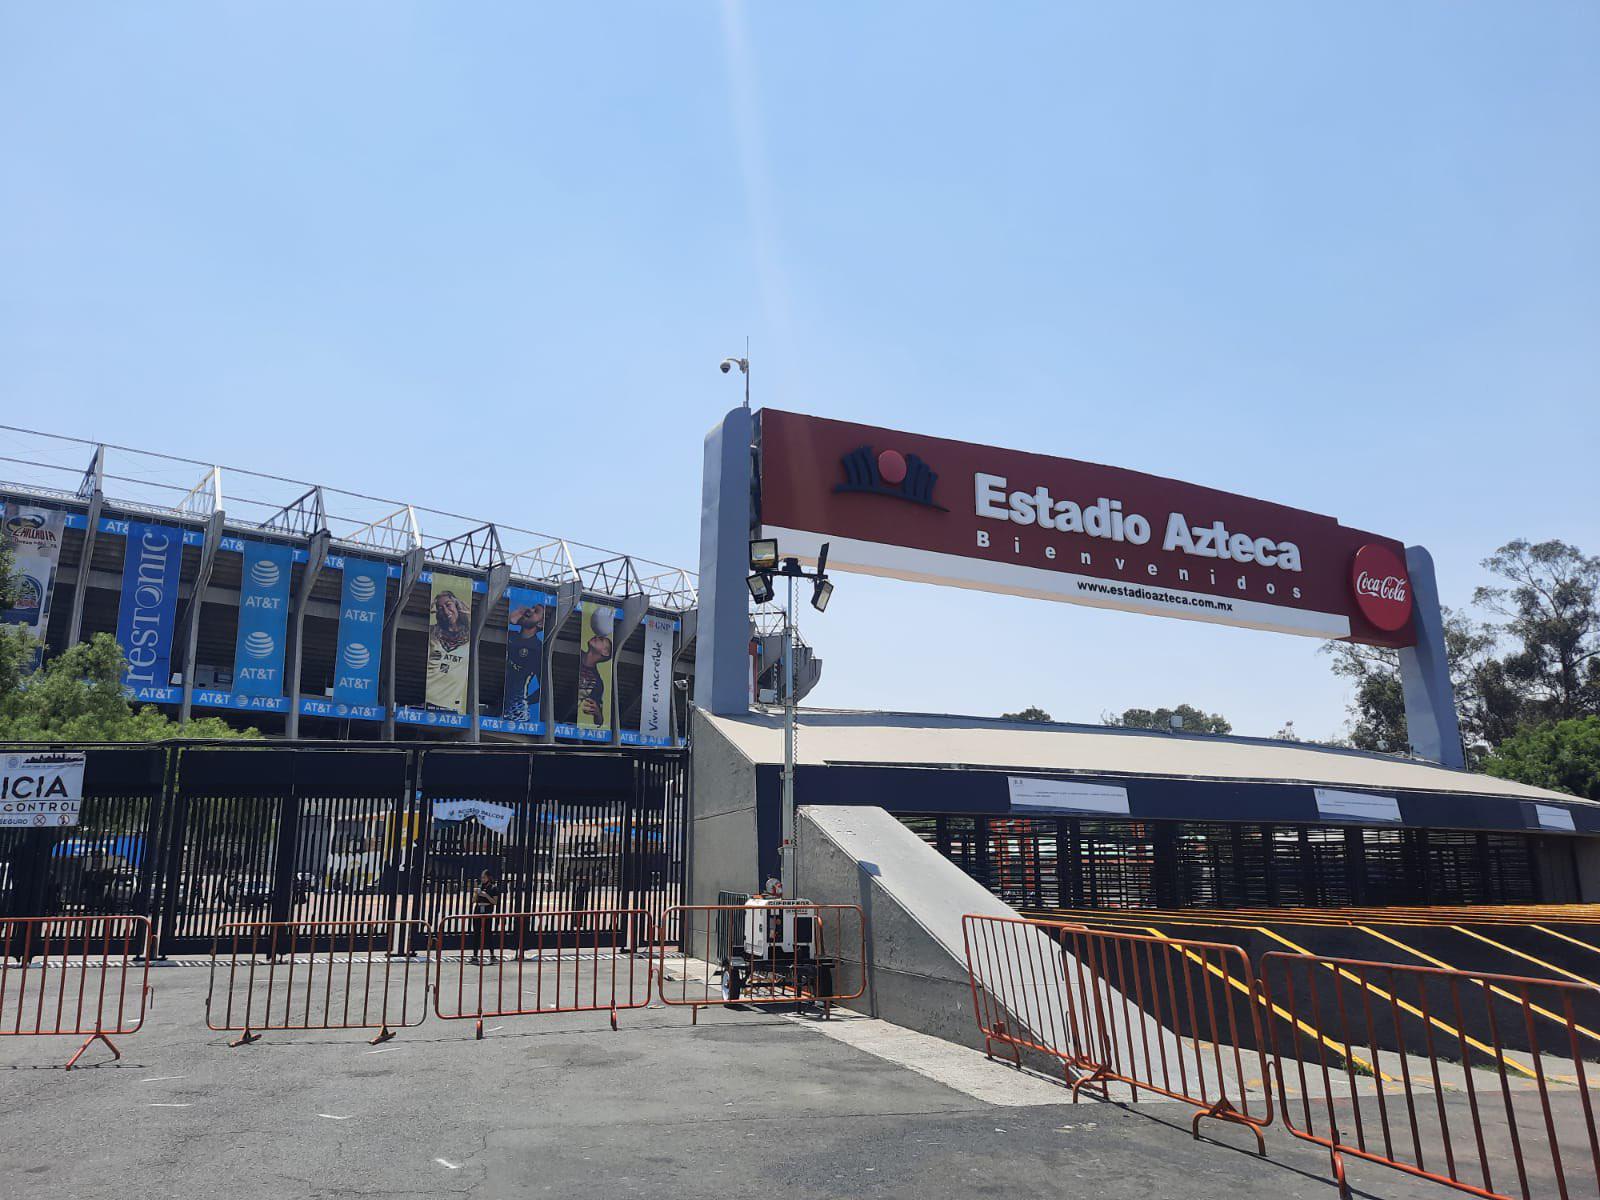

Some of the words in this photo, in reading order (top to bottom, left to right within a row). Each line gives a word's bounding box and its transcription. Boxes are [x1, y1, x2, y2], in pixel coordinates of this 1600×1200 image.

[974, 472, 1151, 545] Estadio
[1162, 511, 1302, 572] Azteca
[976, 530, 1301, 599] Bienvenidos
[1356, 571, 1407, 602] Coca-Cola
[245, 595, 280, 609] AT&T
[1077, 580, 1233, 612] www.estadioazteca.com.mx
[344, 609, 376, 622] AT&T
[239, 668, 275, 681] AT&T
[338, 677, 371, 690] AT&T
[138, 687, 174, 699] AT&T
[199, 692, 230, 705] AT&T
[251, 697, 282, 709] AT&T
[303, 702, 332, 714] AT&T
[350, 707, 378, 718] AT&T
[439, 715, 463, 725] AT&T
[481, 719, 503, 729] AT&T
[517, 723, 539, 733] AT&T
[554, 726, 575, 736] AT&T
[3, 802, 79, 812] CONTROL
